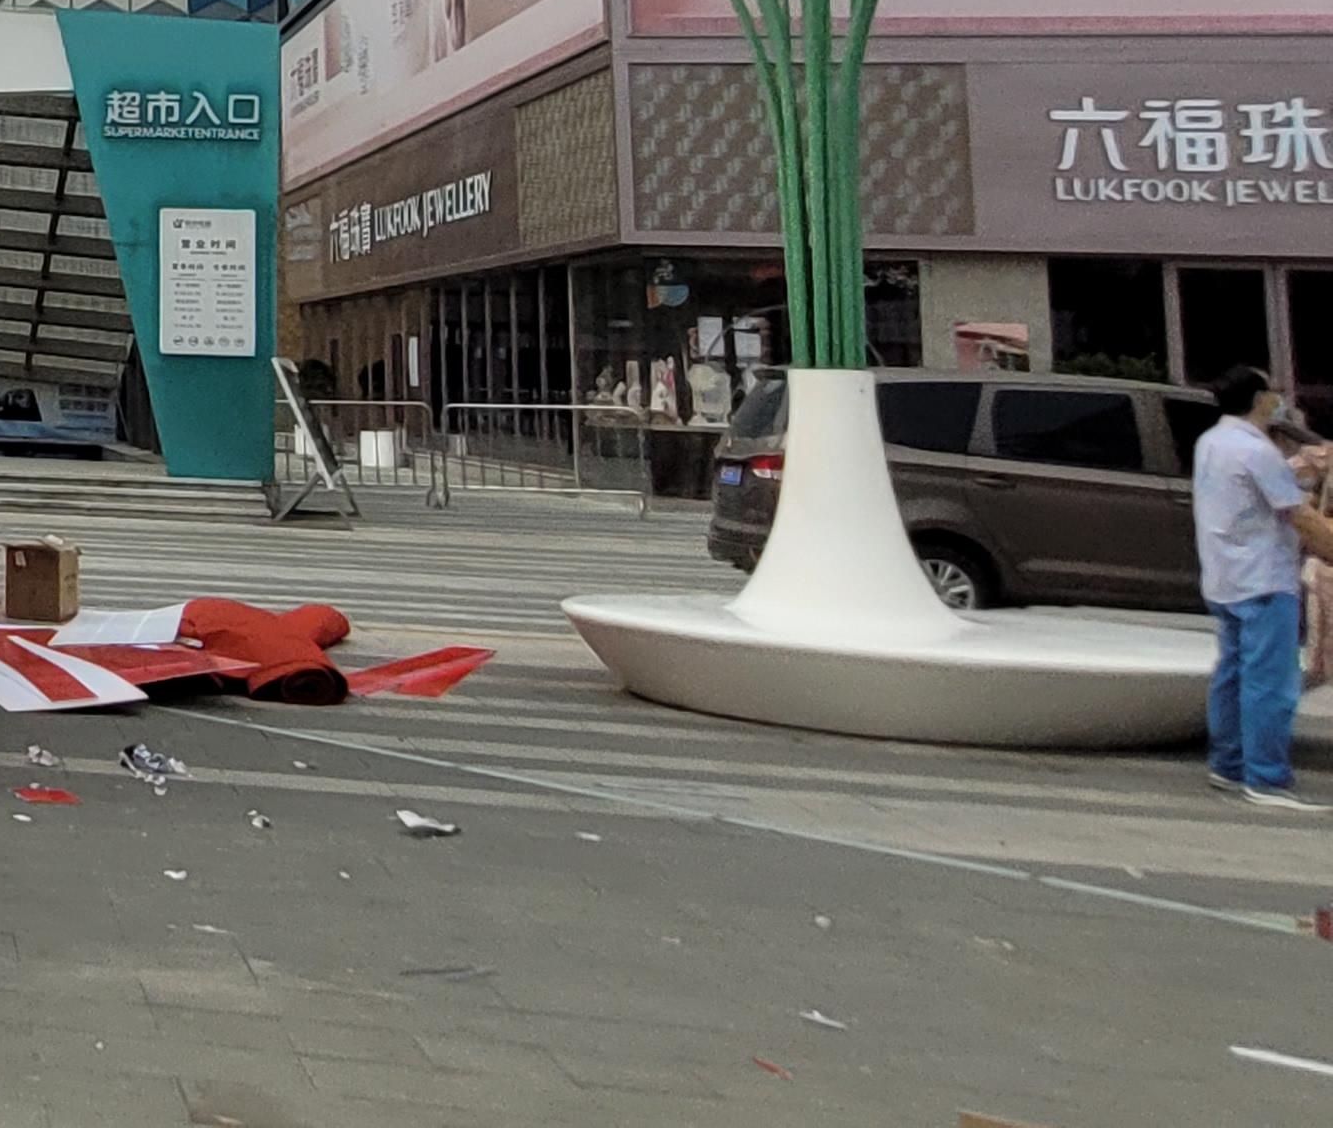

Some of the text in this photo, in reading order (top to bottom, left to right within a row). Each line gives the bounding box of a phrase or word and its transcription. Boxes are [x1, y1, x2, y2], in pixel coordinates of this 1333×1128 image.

[104, 90, 261, 125] 超市入口
[1049, 96, 1333, 173] 六福珠
[374, 169, 492, 242] LUKFOOK JEWELLERY
[1054, 177, 1217, 202] LUKFOOK
